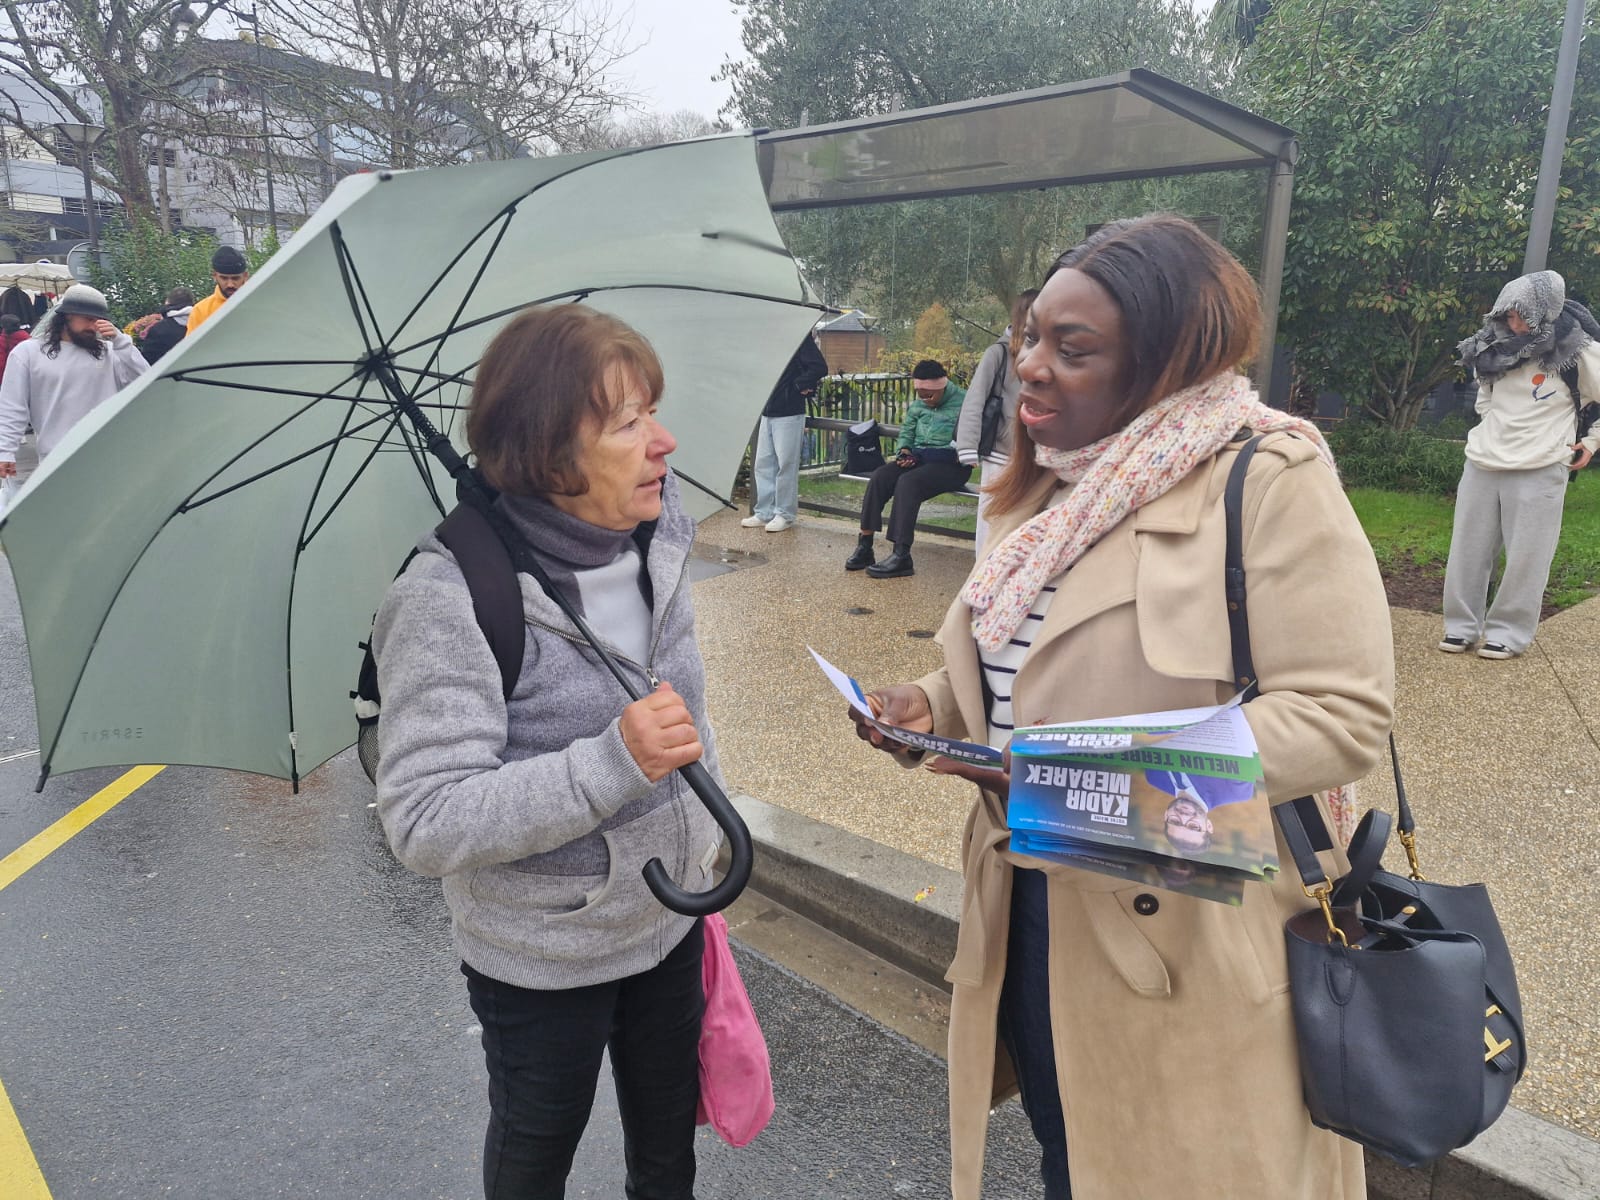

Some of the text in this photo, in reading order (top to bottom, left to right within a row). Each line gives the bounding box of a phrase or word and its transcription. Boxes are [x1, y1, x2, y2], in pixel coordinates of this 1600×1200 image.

[1120, 750, 1174, 766] TERRE
[1180, 754, 1240, 774] MELUN
[1024, 764, 1131, 795] MEBAREK
[1066, 788, 1130, 817] KADIR
